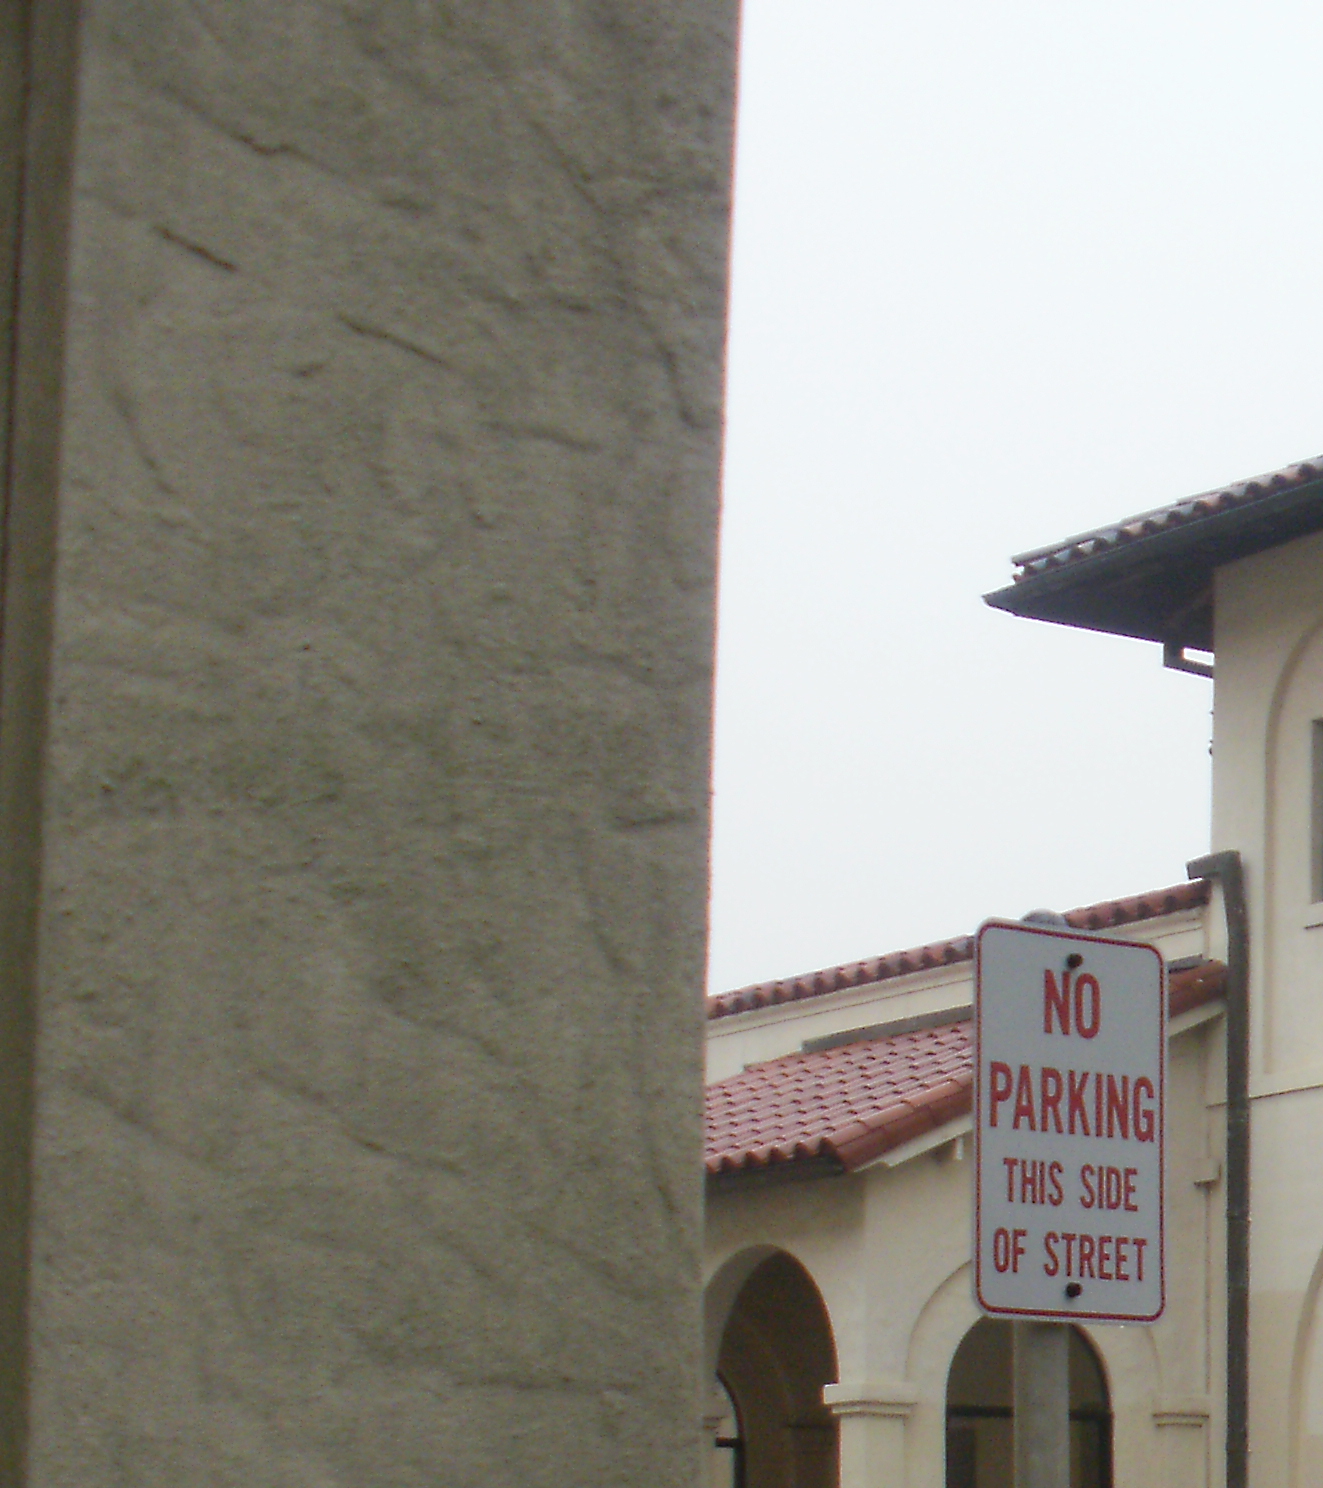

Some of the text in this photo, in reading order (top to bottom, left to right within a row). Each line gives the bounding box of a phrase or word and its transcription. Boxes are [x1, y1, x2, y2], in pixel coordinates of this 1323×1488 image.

[1043, 968, 1101, 1039] NO
[988, 1061, 1156, 1143] PARKING
[1003, 1156, 1139, 1213] THIS SIDE
[992, 1226, 1148, 1282] OF STREET
